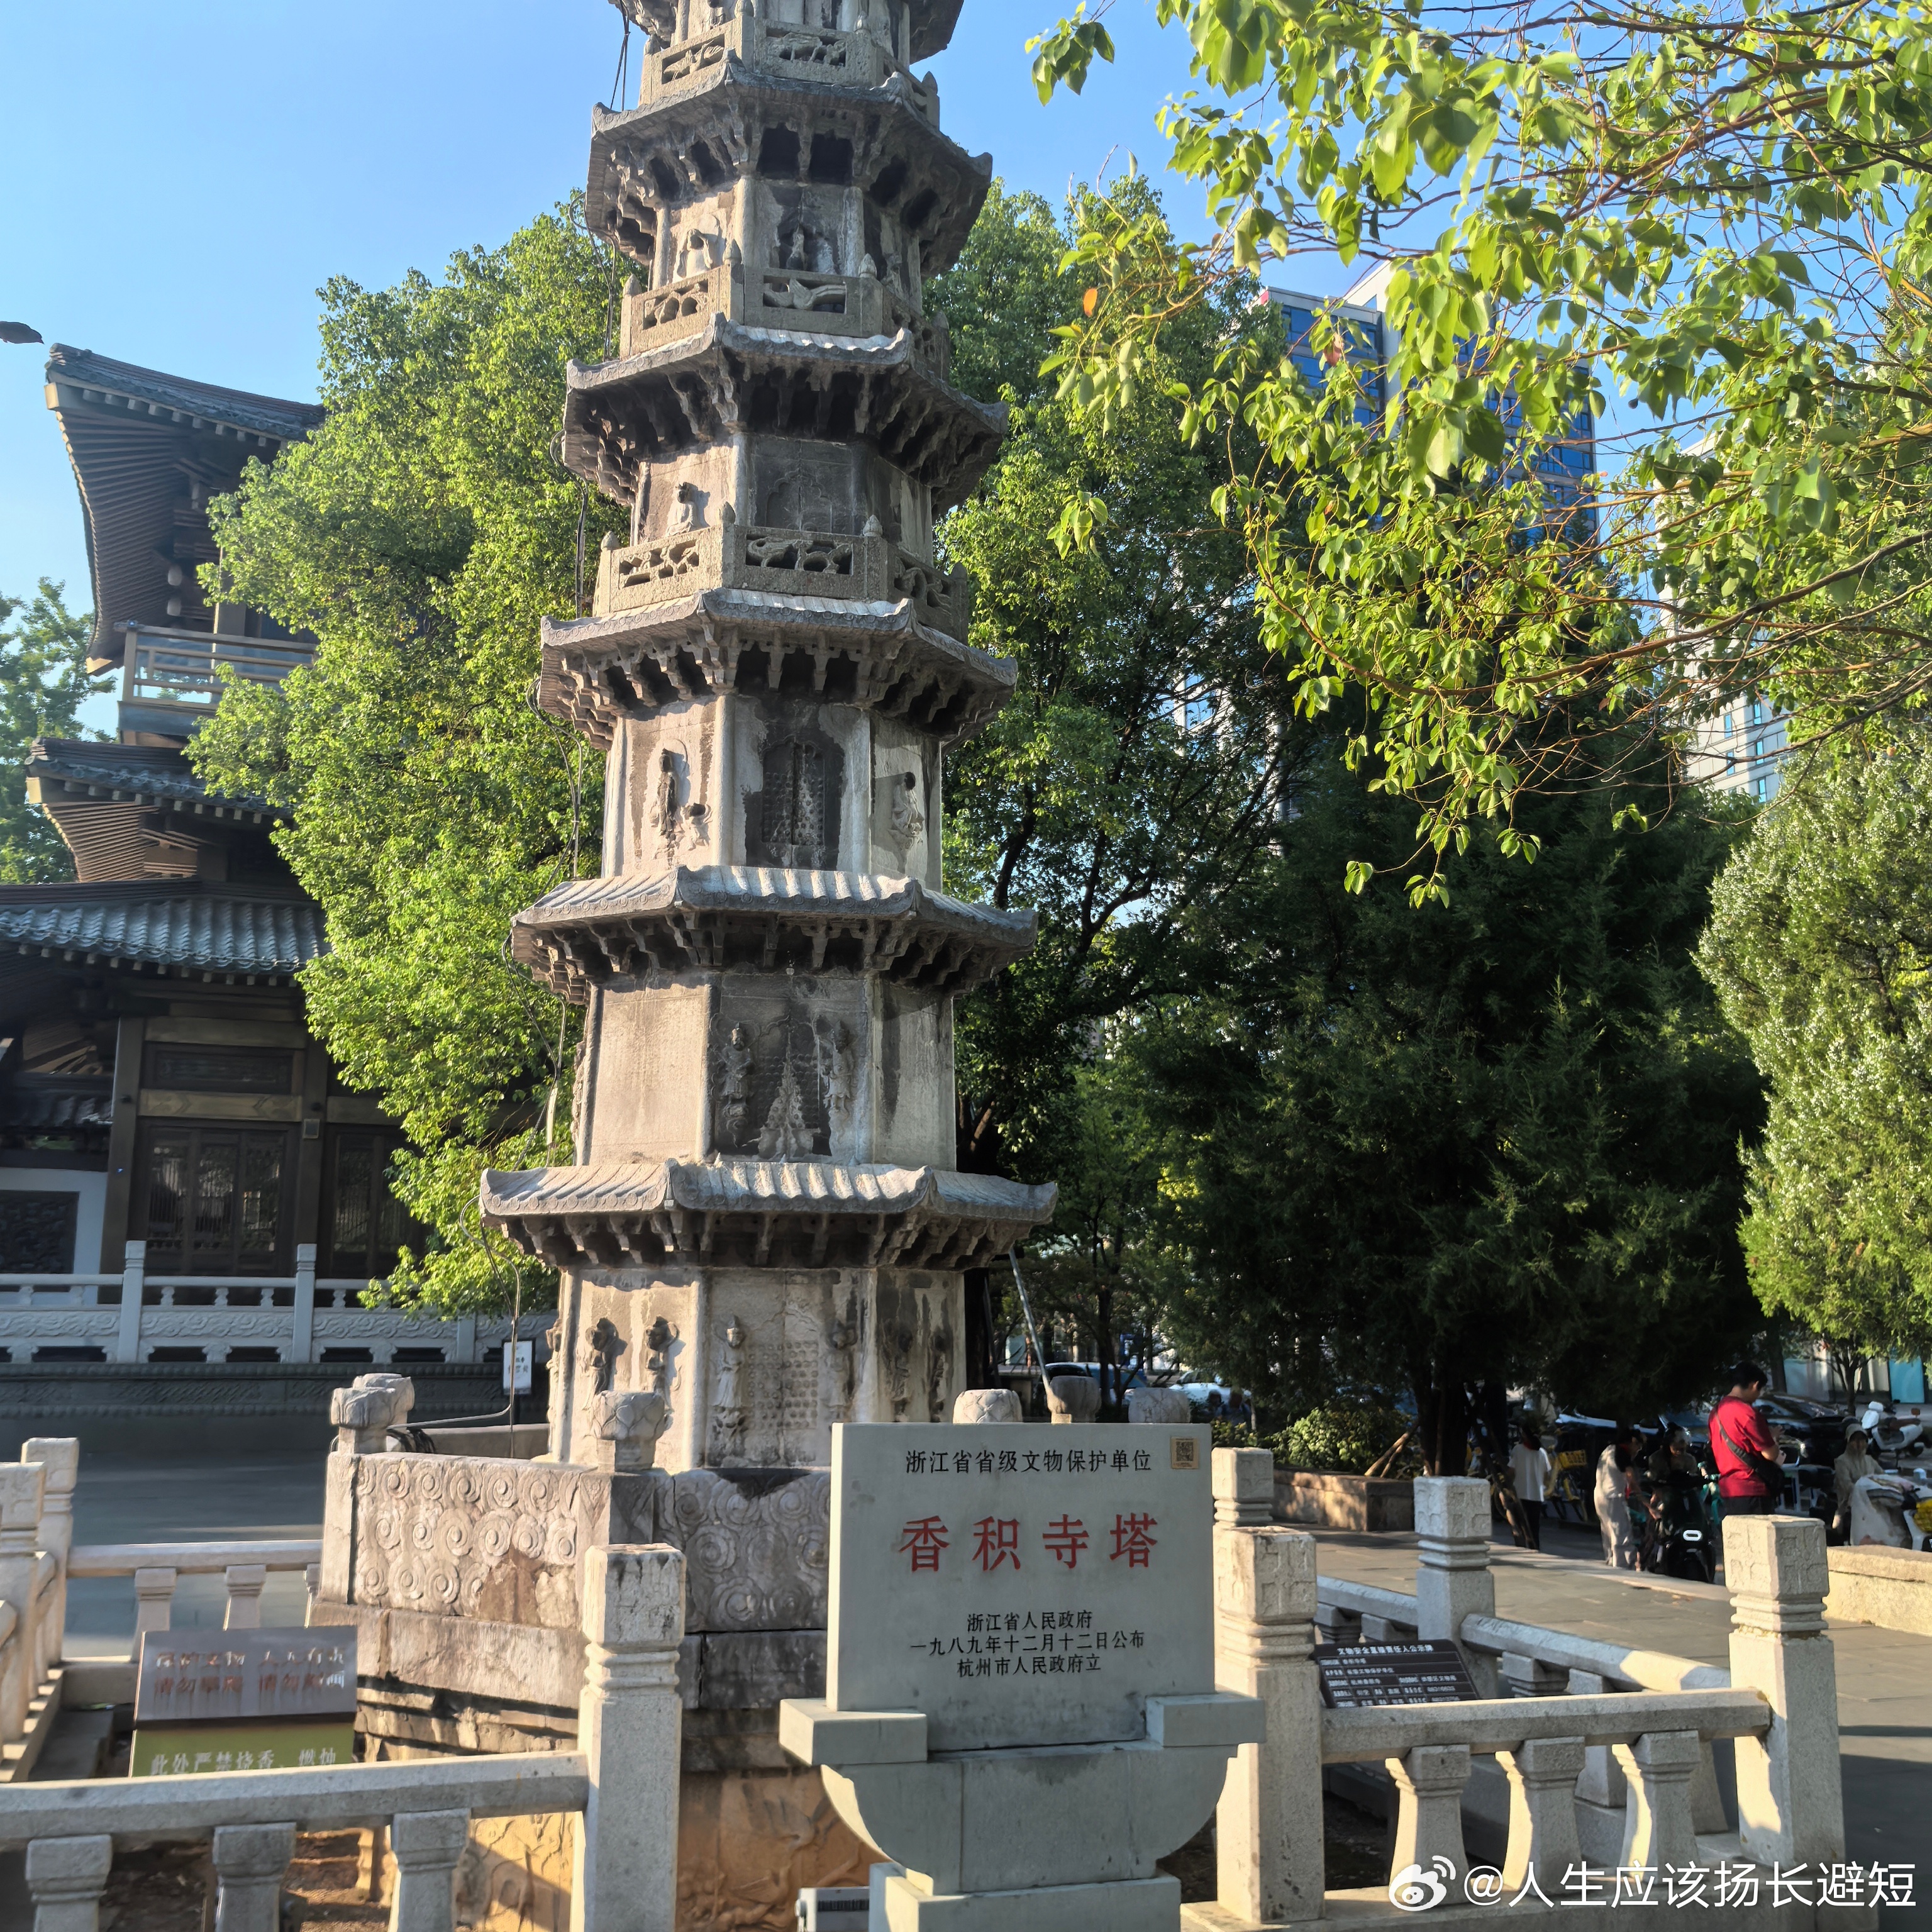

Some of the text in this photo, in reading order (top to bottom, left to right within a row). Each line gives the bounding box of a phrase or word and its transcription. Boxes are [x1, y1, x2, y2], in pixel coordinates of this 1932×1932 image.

[906, 1450, 1152, 1474] 浙江省省级文物保护单位
[899, 1513, 1158, 1572] 香积寺塔
[967, 1610, 1093, 1633] 浙江省人民政府
[910, 1630, 1145, 1657] 一九八九年十二月十二日公布
[957, 1655, 1102, 1678] 杭州市人民政府立
